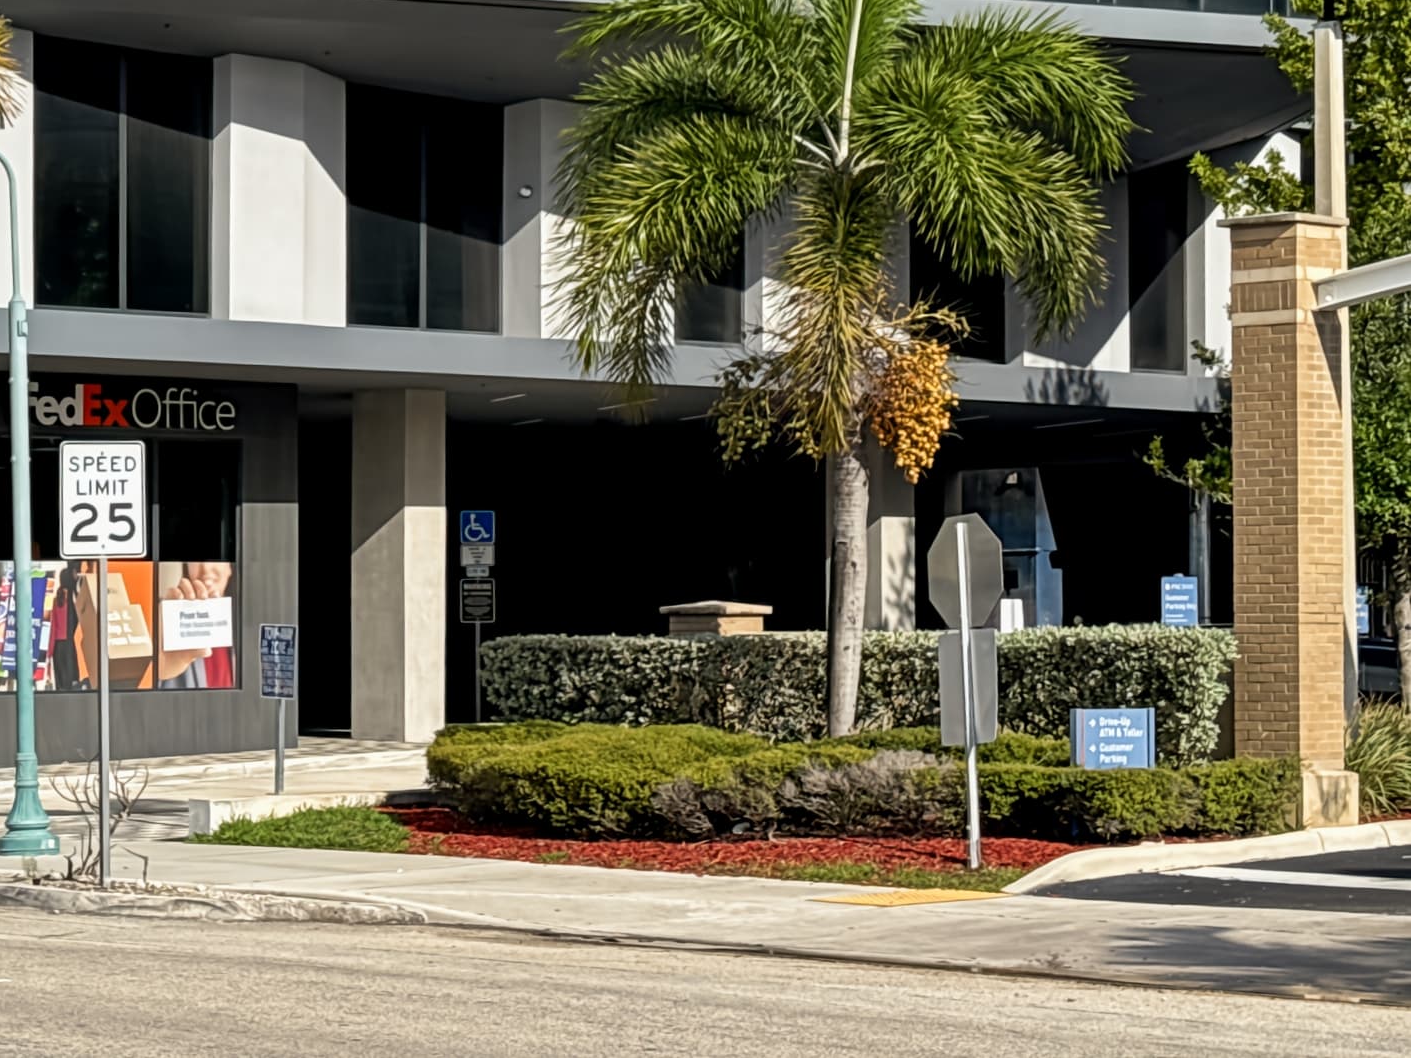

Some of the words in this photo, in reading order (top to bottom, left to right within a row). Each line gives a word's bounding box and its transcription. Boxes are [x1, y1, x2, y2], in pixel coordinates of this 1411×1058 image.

[132, 388, 236, 431] Office
[69, 456, 137, 473] SPEED
[76, 480, 129, 496] LIMIT
[70, 502, 136, 543] 25
